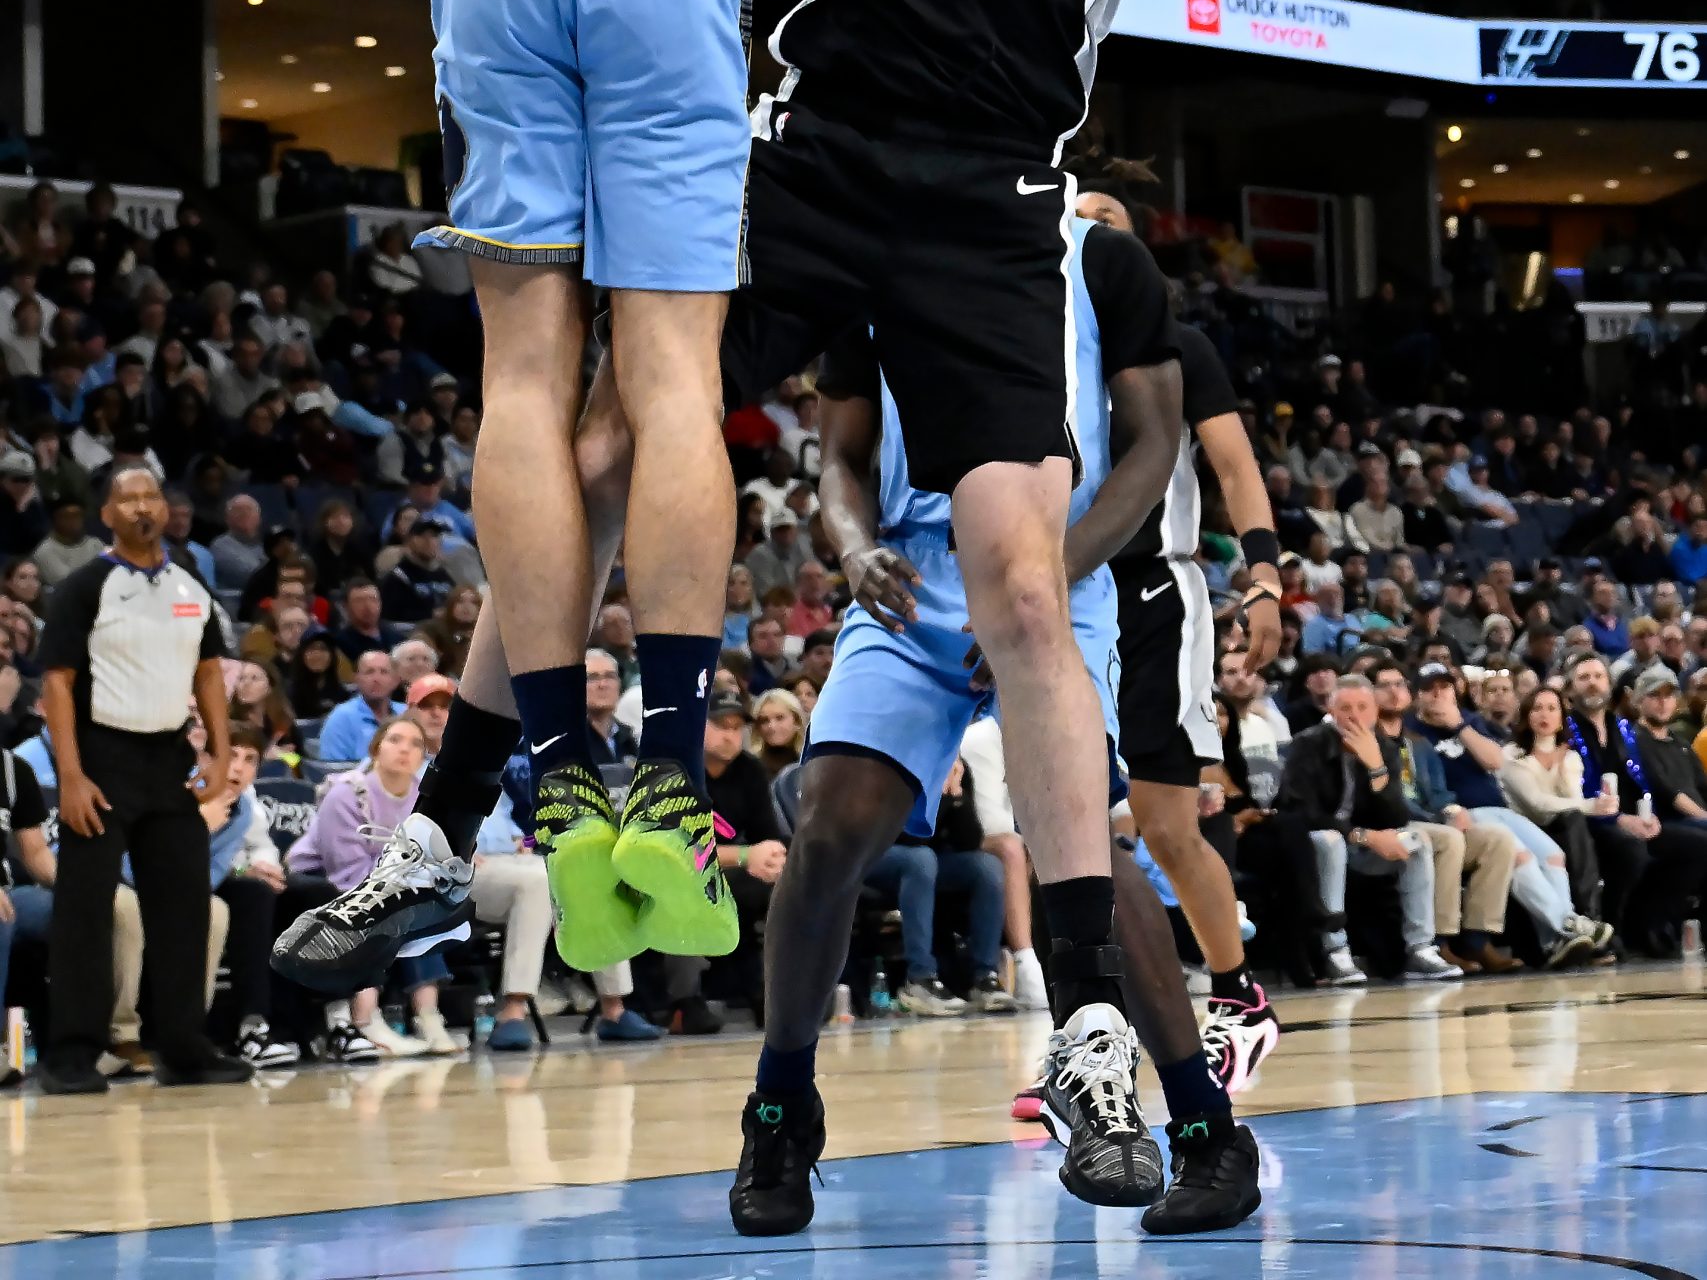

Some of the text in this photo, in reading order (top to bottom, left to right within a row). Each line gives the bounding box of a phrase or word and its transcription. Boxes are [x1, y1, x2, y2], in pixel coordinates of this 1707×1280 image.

[1284, 3, 1350, 28] HUTTON
[1250, 22, 1327, 48] TOYOTA
[1623, 31, 1700, 81] 76
